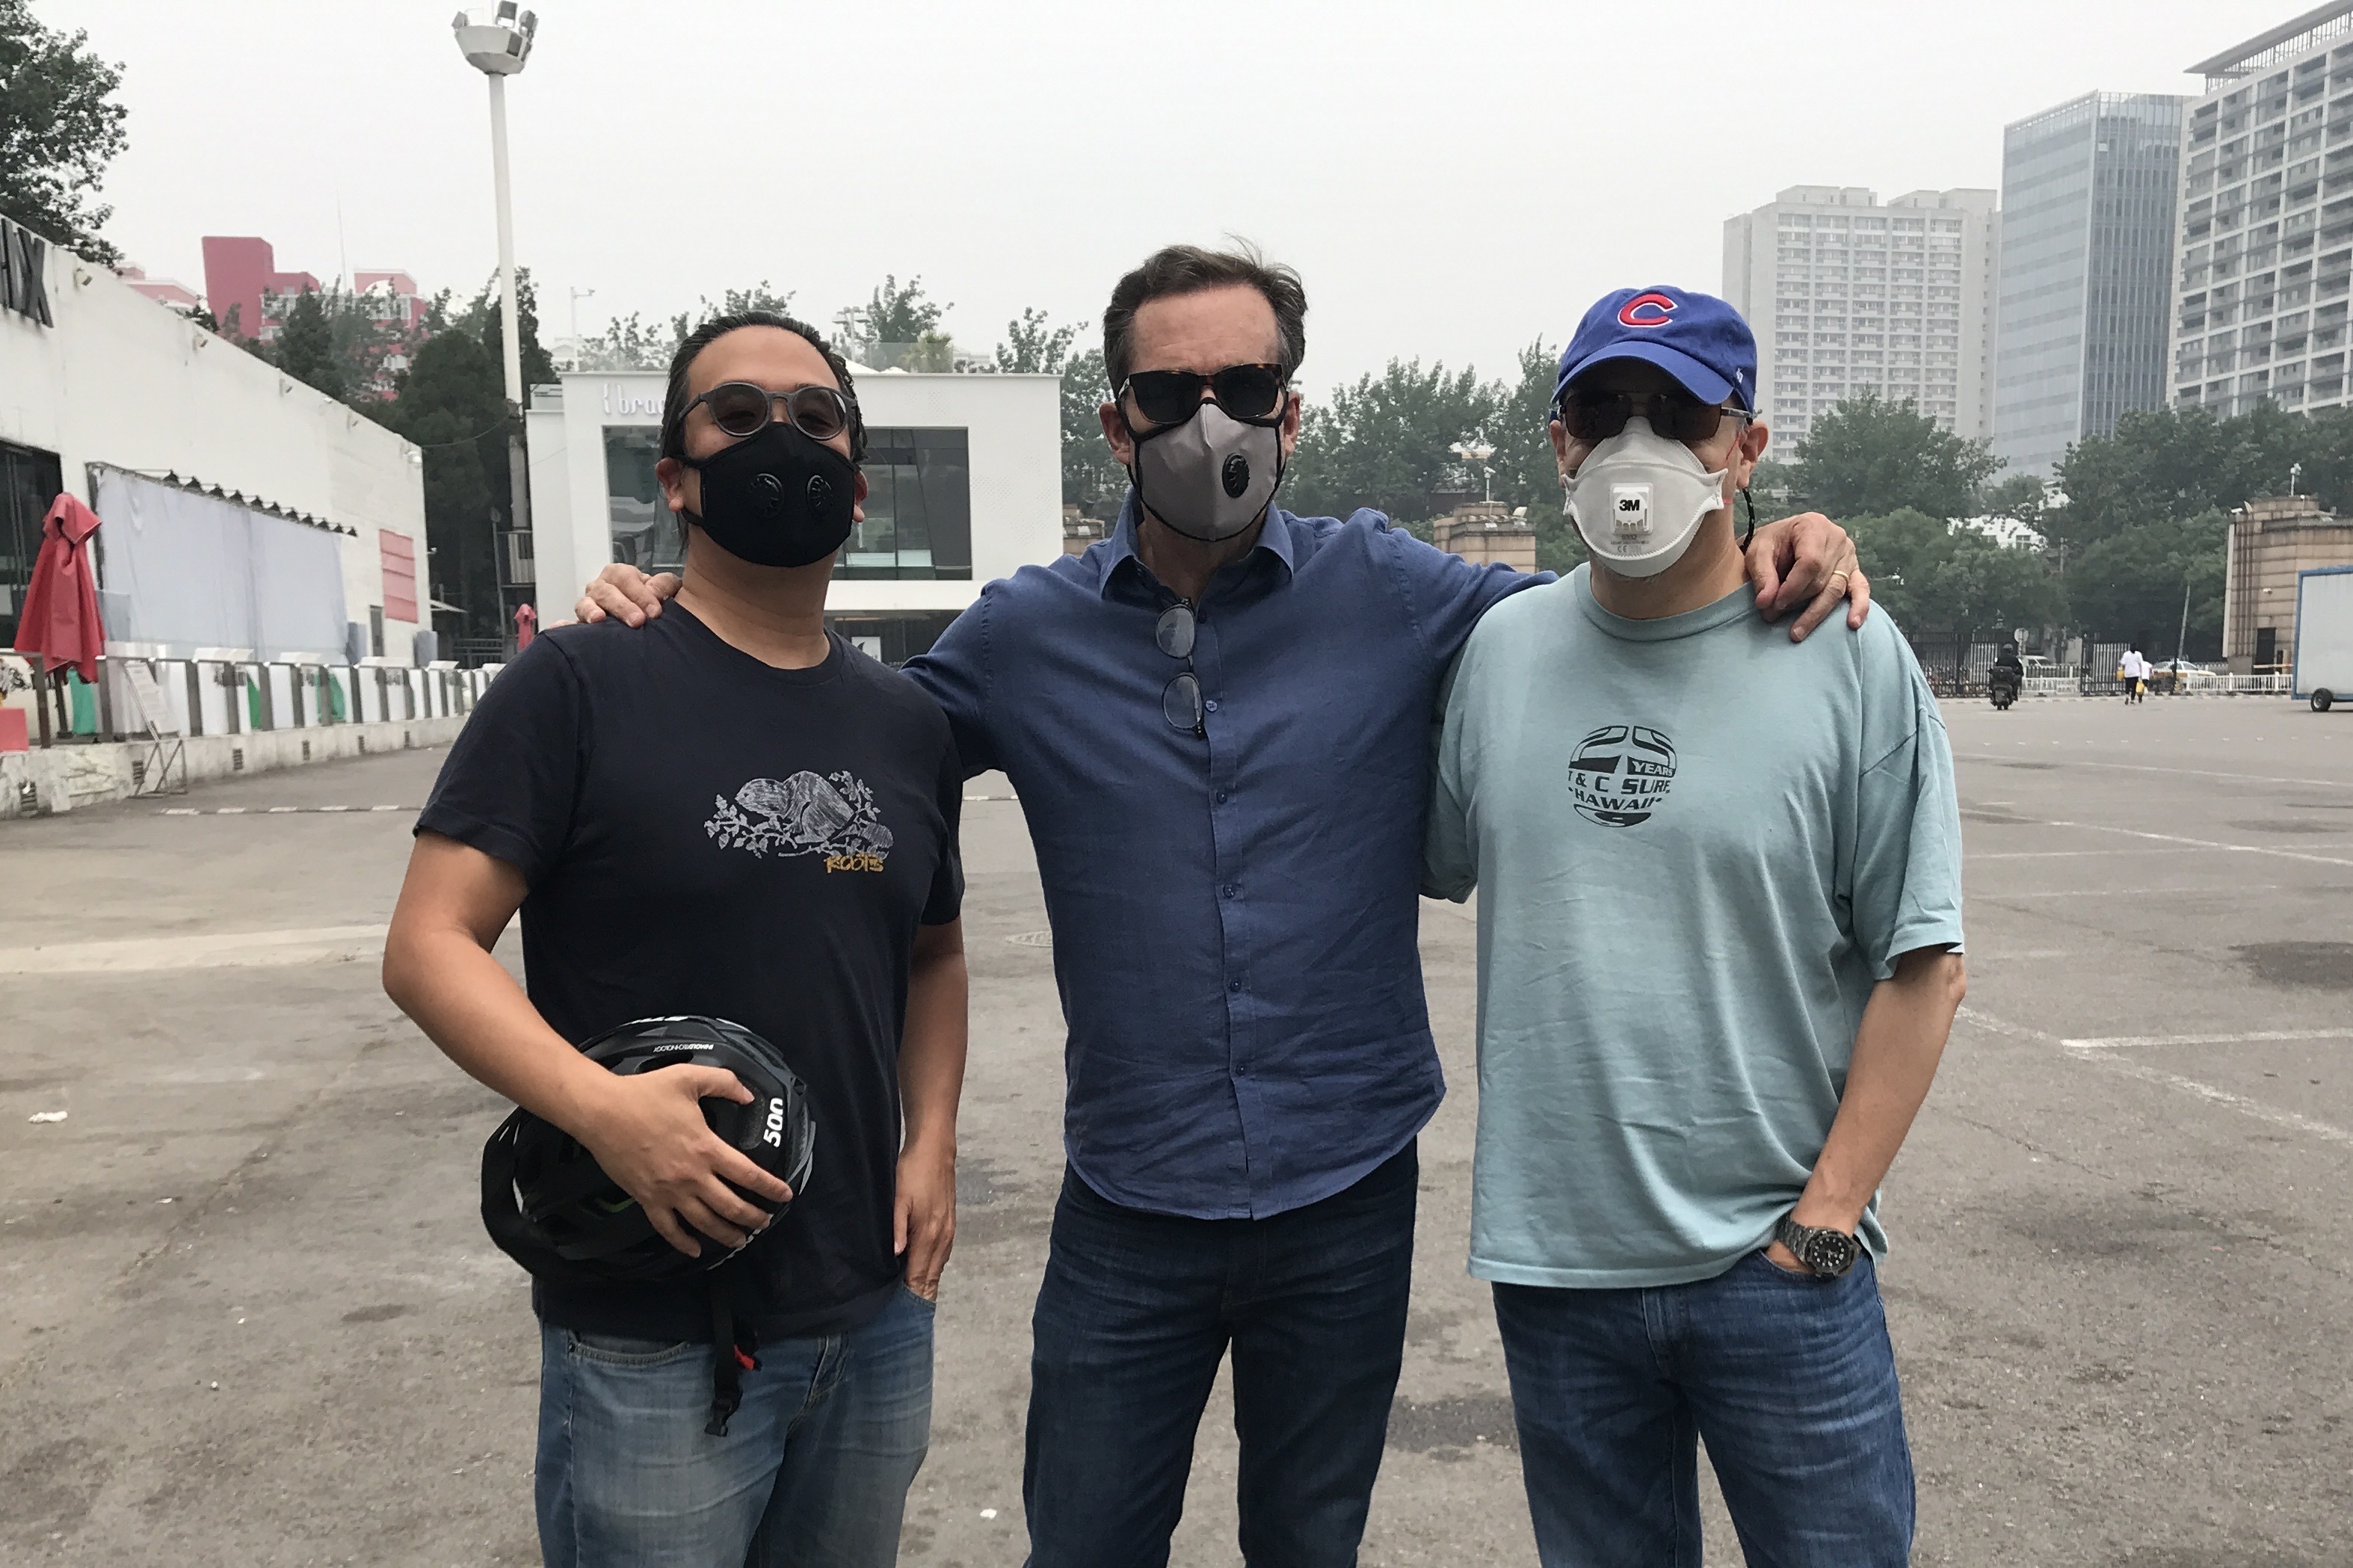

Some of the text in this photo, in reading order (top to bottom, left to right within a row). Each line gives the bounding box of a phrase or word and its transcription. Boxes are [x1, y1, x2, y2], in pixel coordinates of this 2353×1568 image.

[1618, 293, 1679, 327] C
[1619, 499, 1640, 511] 3M
[1632, 760, 1674, 777] YEARS
[1575, 772, 1587, 788] &
[1594, 776, 1610, 792] C
[763, 1097, 783, 1147] 500
